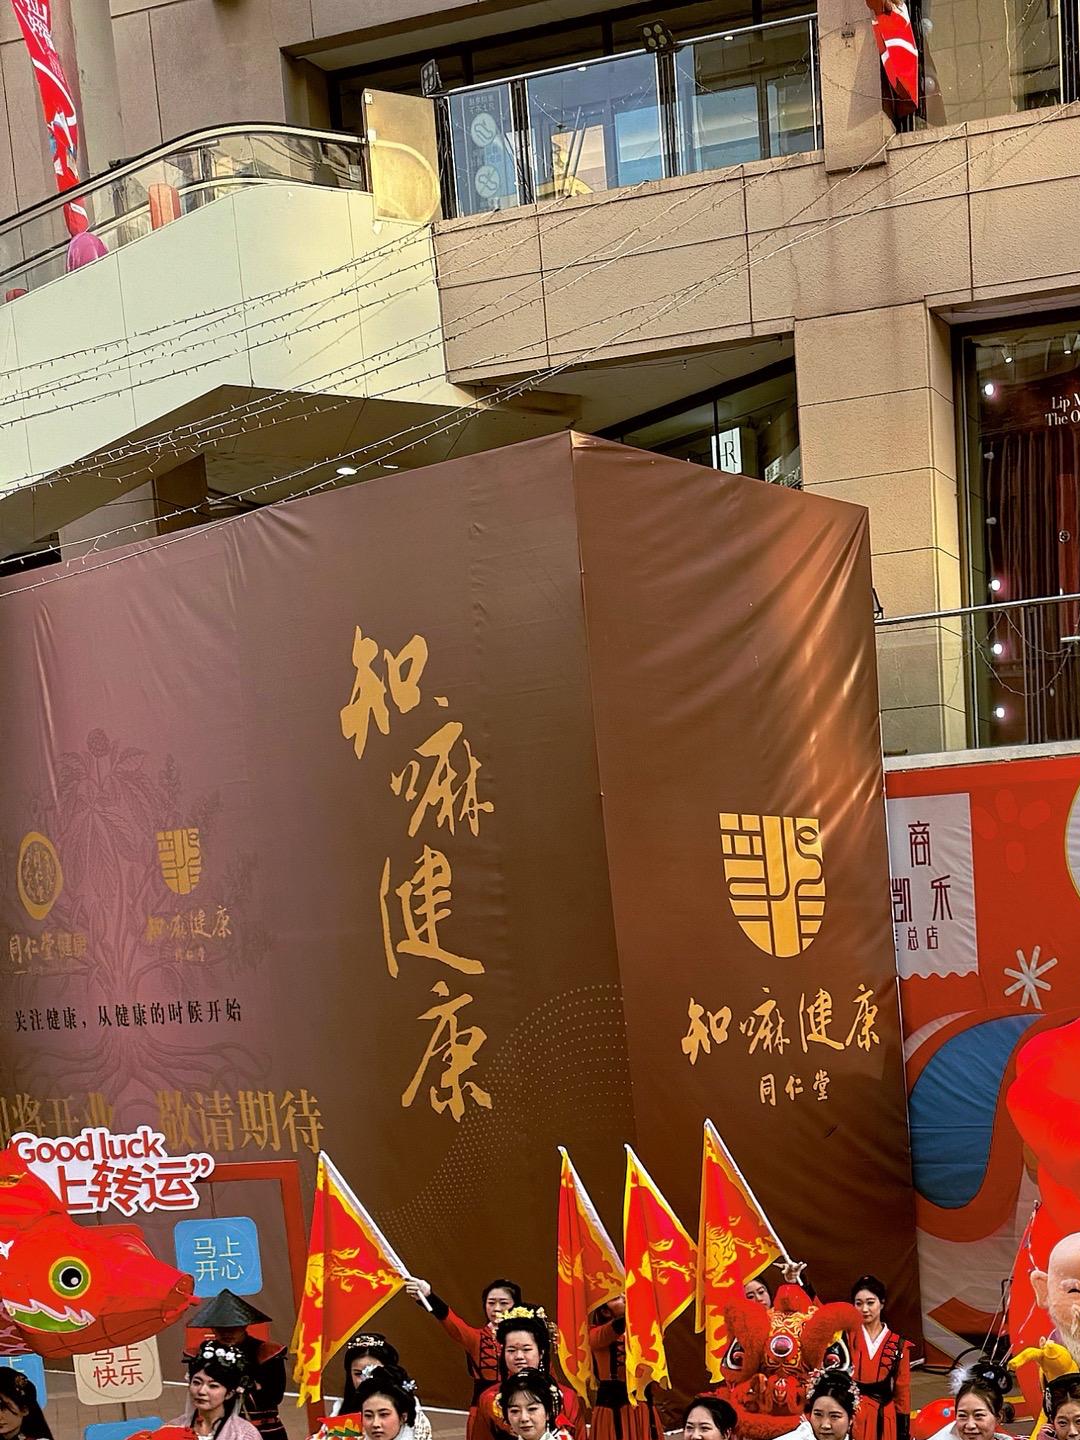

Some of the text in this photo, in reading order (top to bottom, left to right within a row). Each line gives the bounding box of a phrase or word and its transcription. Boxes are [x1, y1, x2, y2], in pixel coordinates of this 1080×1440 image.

[1052, 396, 1071, 412] Lip
[1045, 412, 1068, 426] The
[894, 925, 939, 951] 总店
[759, 1069, 831, 1106] 同仁堂
[158, 1088, 325, 1153] 敬请期待
[14, 1131, 162, 1164] Good luck
[193, 1236, 242, 1259] 马上
[195, 1259, 245, 1282] 开心
[93, 1365, 145, 1389] 快乐
